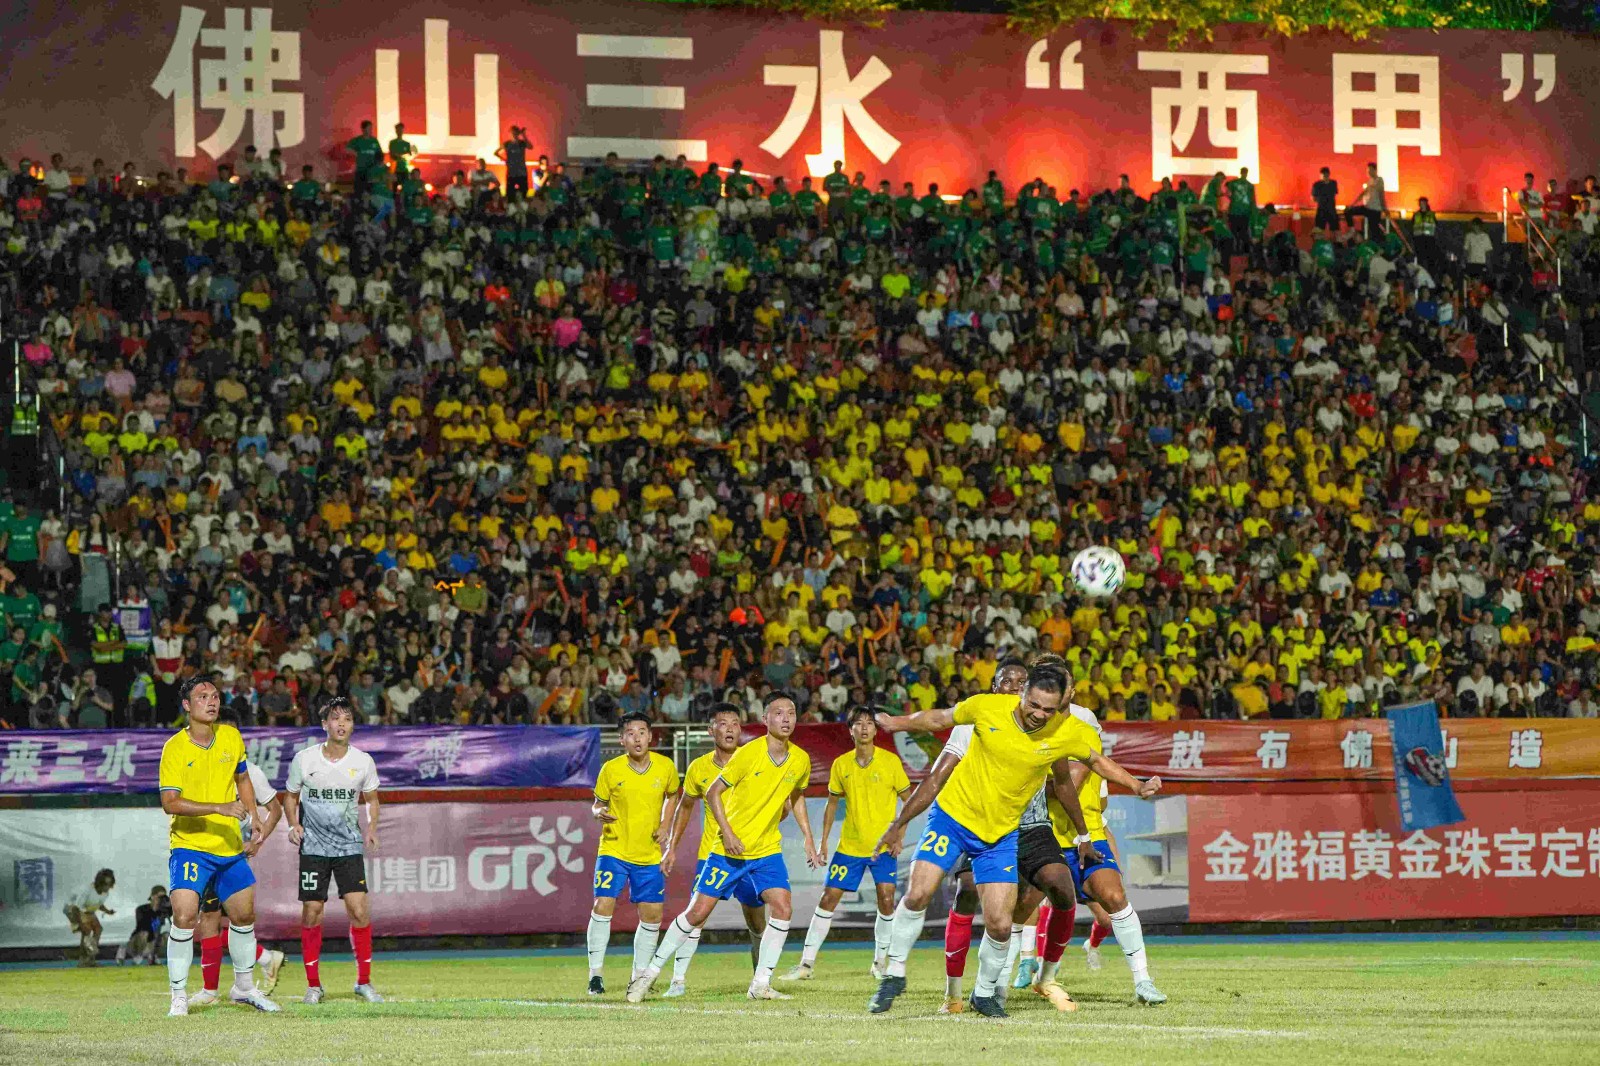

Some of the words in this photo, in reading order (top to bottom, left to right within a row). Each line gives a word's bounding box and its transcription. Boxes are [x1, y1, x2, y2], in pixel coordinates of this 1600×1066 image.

[920, 830, 950, 857] 28
[182, 861, 199, 882] 13
[301, 871, 319, 891] 25
[594, 870, 613, 889] 32
[705, 866, 730, 890] 37
[829, 863, 849, 882] 99
